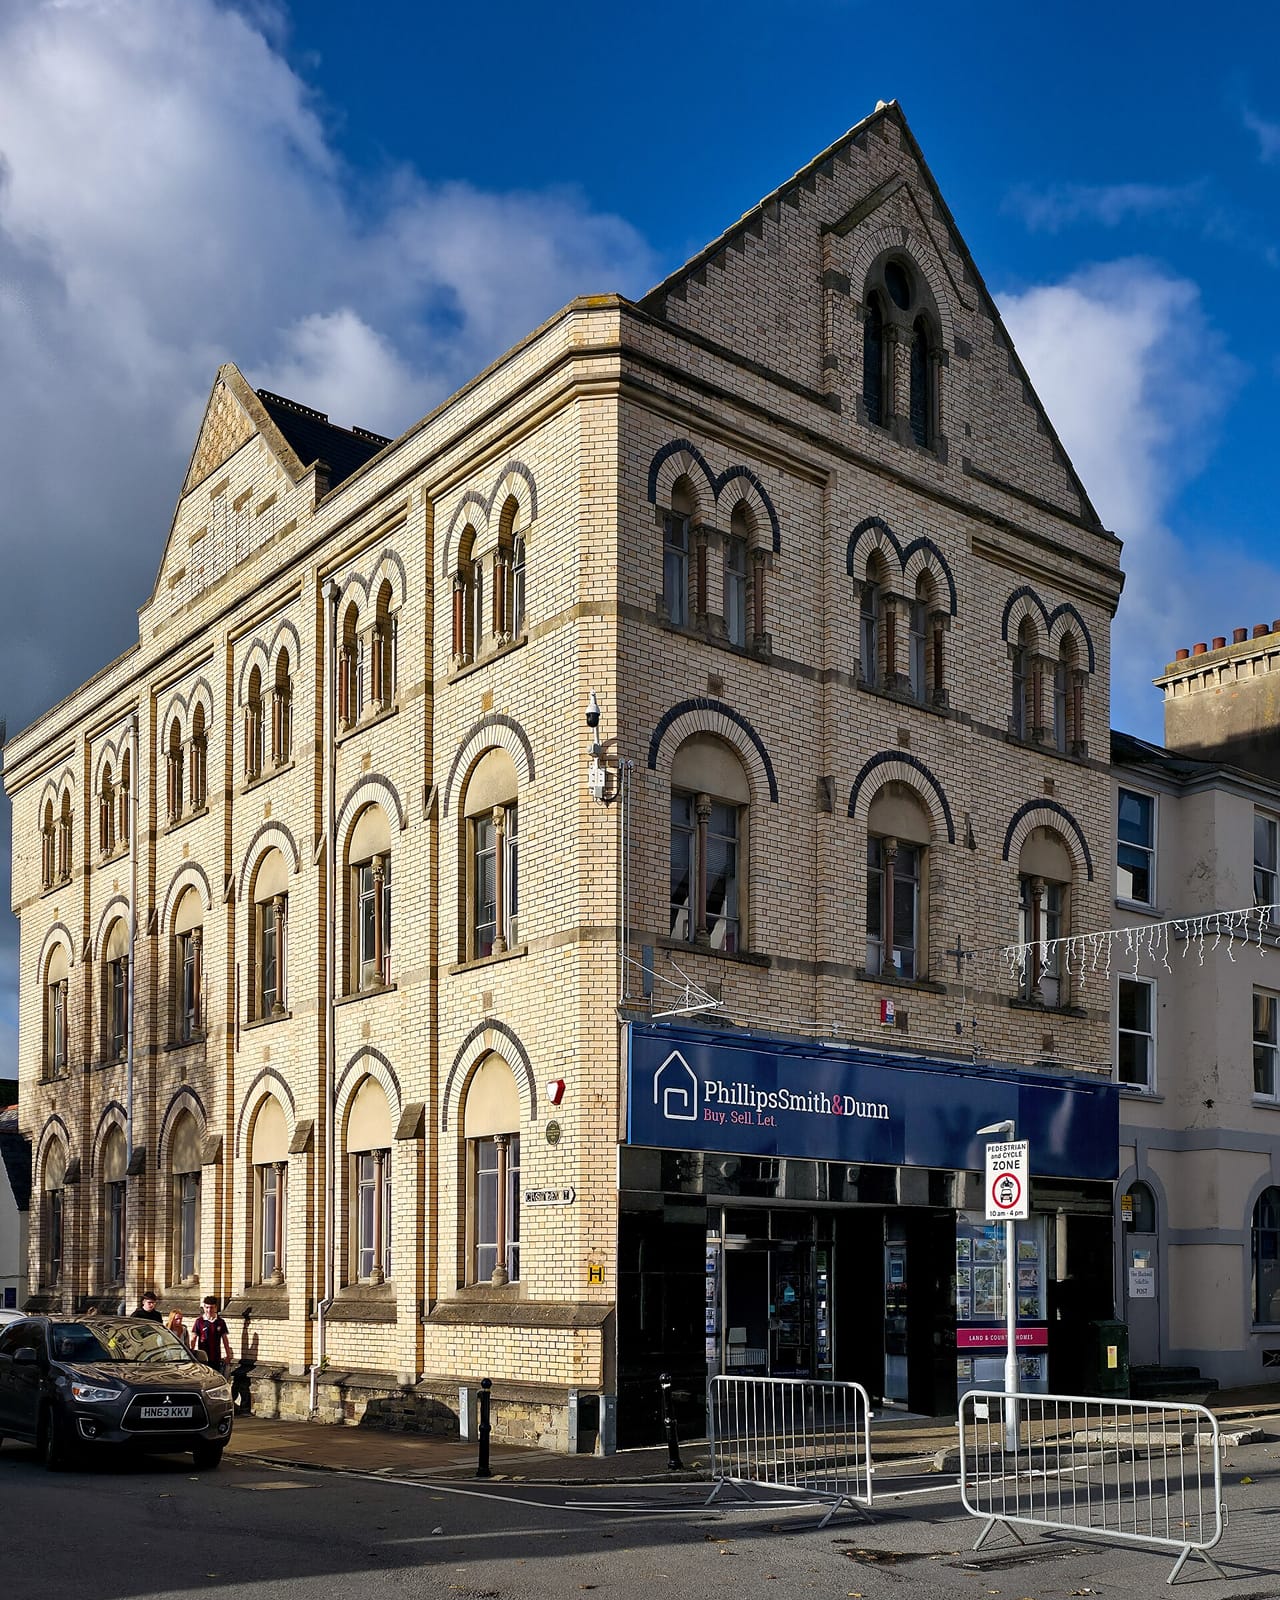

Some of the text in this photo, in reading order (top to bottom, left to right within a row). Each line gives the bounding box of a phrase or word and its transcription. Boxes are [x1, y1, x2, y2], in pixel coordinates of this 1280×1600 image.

[704, 1080, 890, 1120] PhillipsSmith&Dunn
[704, 1108, 777, 1127] Buy. Sell. Let.
[988, 1143, 1026, 1152] PEDESTRIAN
[993, 1160, 1020, 1171] ZONE
[590, 1267, 601, 1281] H
[144, 1408, 190, 1416] HN63 KKV
